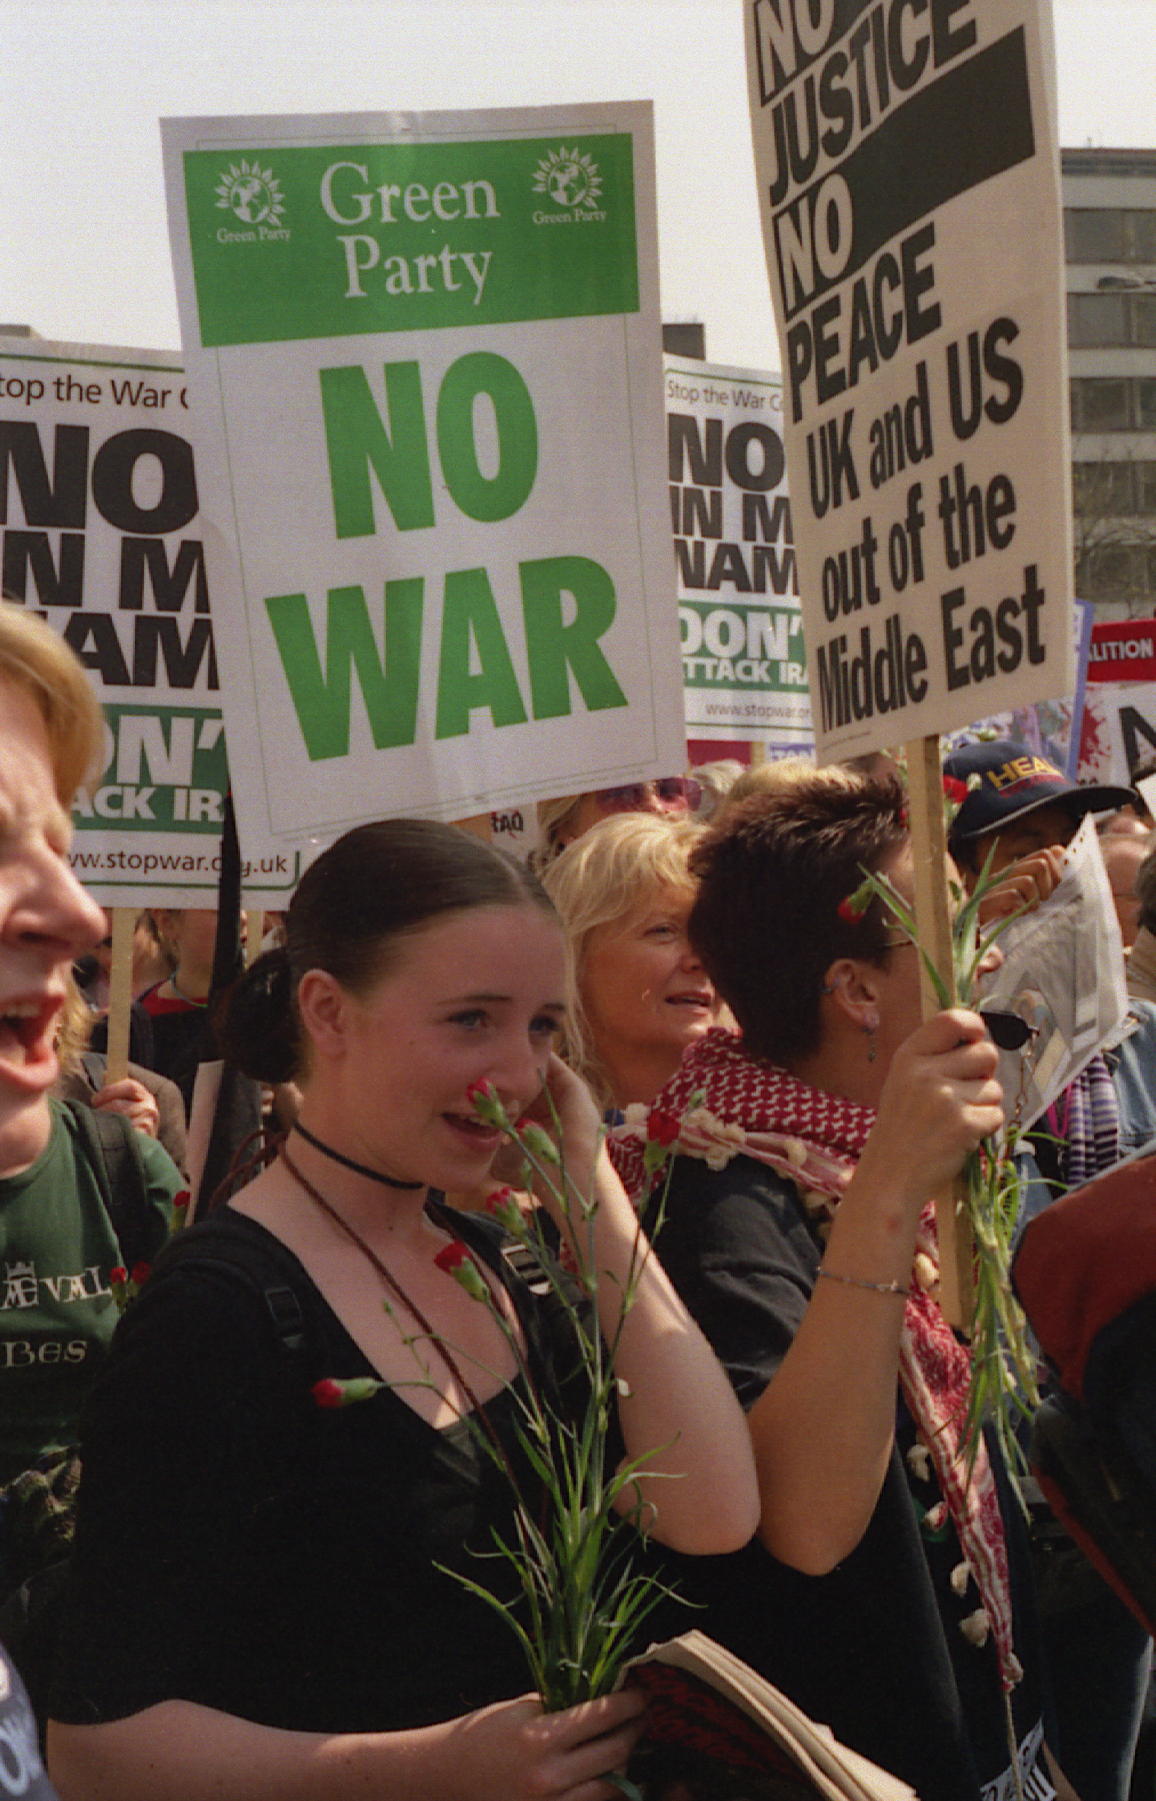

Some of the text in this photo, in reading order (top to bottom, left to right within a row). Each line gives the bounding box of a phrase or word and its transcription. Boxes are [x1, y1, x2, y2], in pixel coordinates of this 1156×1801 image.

[756, 0, 834, 98] NO
[770, 0, 977, 207] JUSTICE
[216, 225, 291, 242] Green Party
[320, 161, 501, 226] Green
[532, 207, 607, 224] Green Party
[337, 235, 493, 306] Party
[778, 173, 853, 319] NO
[787, 221, 942, 424] PEACE
[53, 375, 101, 403] the
[110, 379, 172, 408] War
[667, 380, 699, 404] Stop
[704, 386, 728, 406] the
[731, 390, 766, 409] War
[806, 317, 1024, 519] UK and US
[0, 420, 199, 535] NO
[319, 351, 539, 540] NO
[667, 412, 785, 492] NO
[669, 485, 794, 544] IN M
[822, 463, 1017, 622] out of the
[674, 538, 800, 596] NAM
[35, 611, 220, 690] AM
[264, 555, 629, 761] WAR
[817, 564, 1045, 734] Middle East
